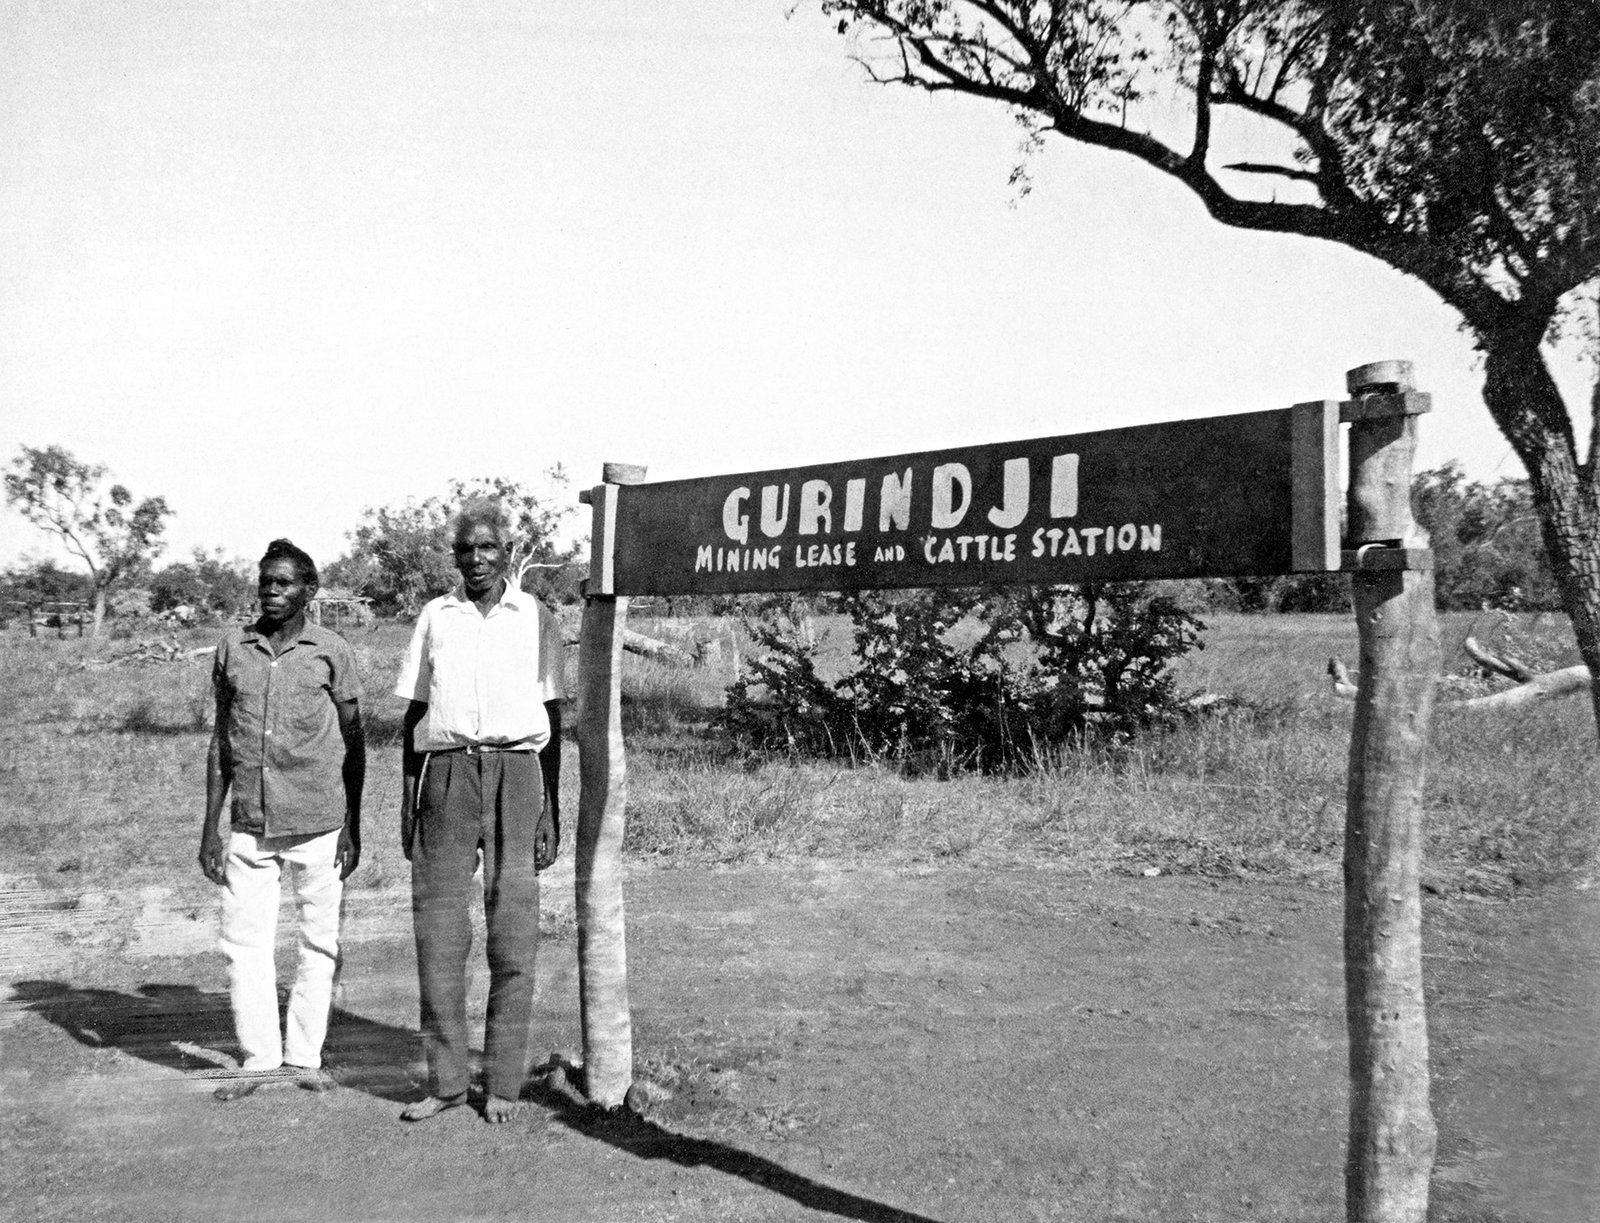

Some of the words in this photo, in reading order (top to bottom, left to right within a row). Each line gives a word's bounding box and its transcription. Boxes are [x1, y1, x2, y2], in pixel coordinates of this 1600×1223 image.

[722, 452, 1080, 546] GURINDJI
[694, 544, 782, 573] MINING
[795, 541, 857, 568] LEASE
[873, 544, 906, 563] AND
[923, 534, 1018, 565] CATTLE
[1031, 522, 1162, 558] STATION
